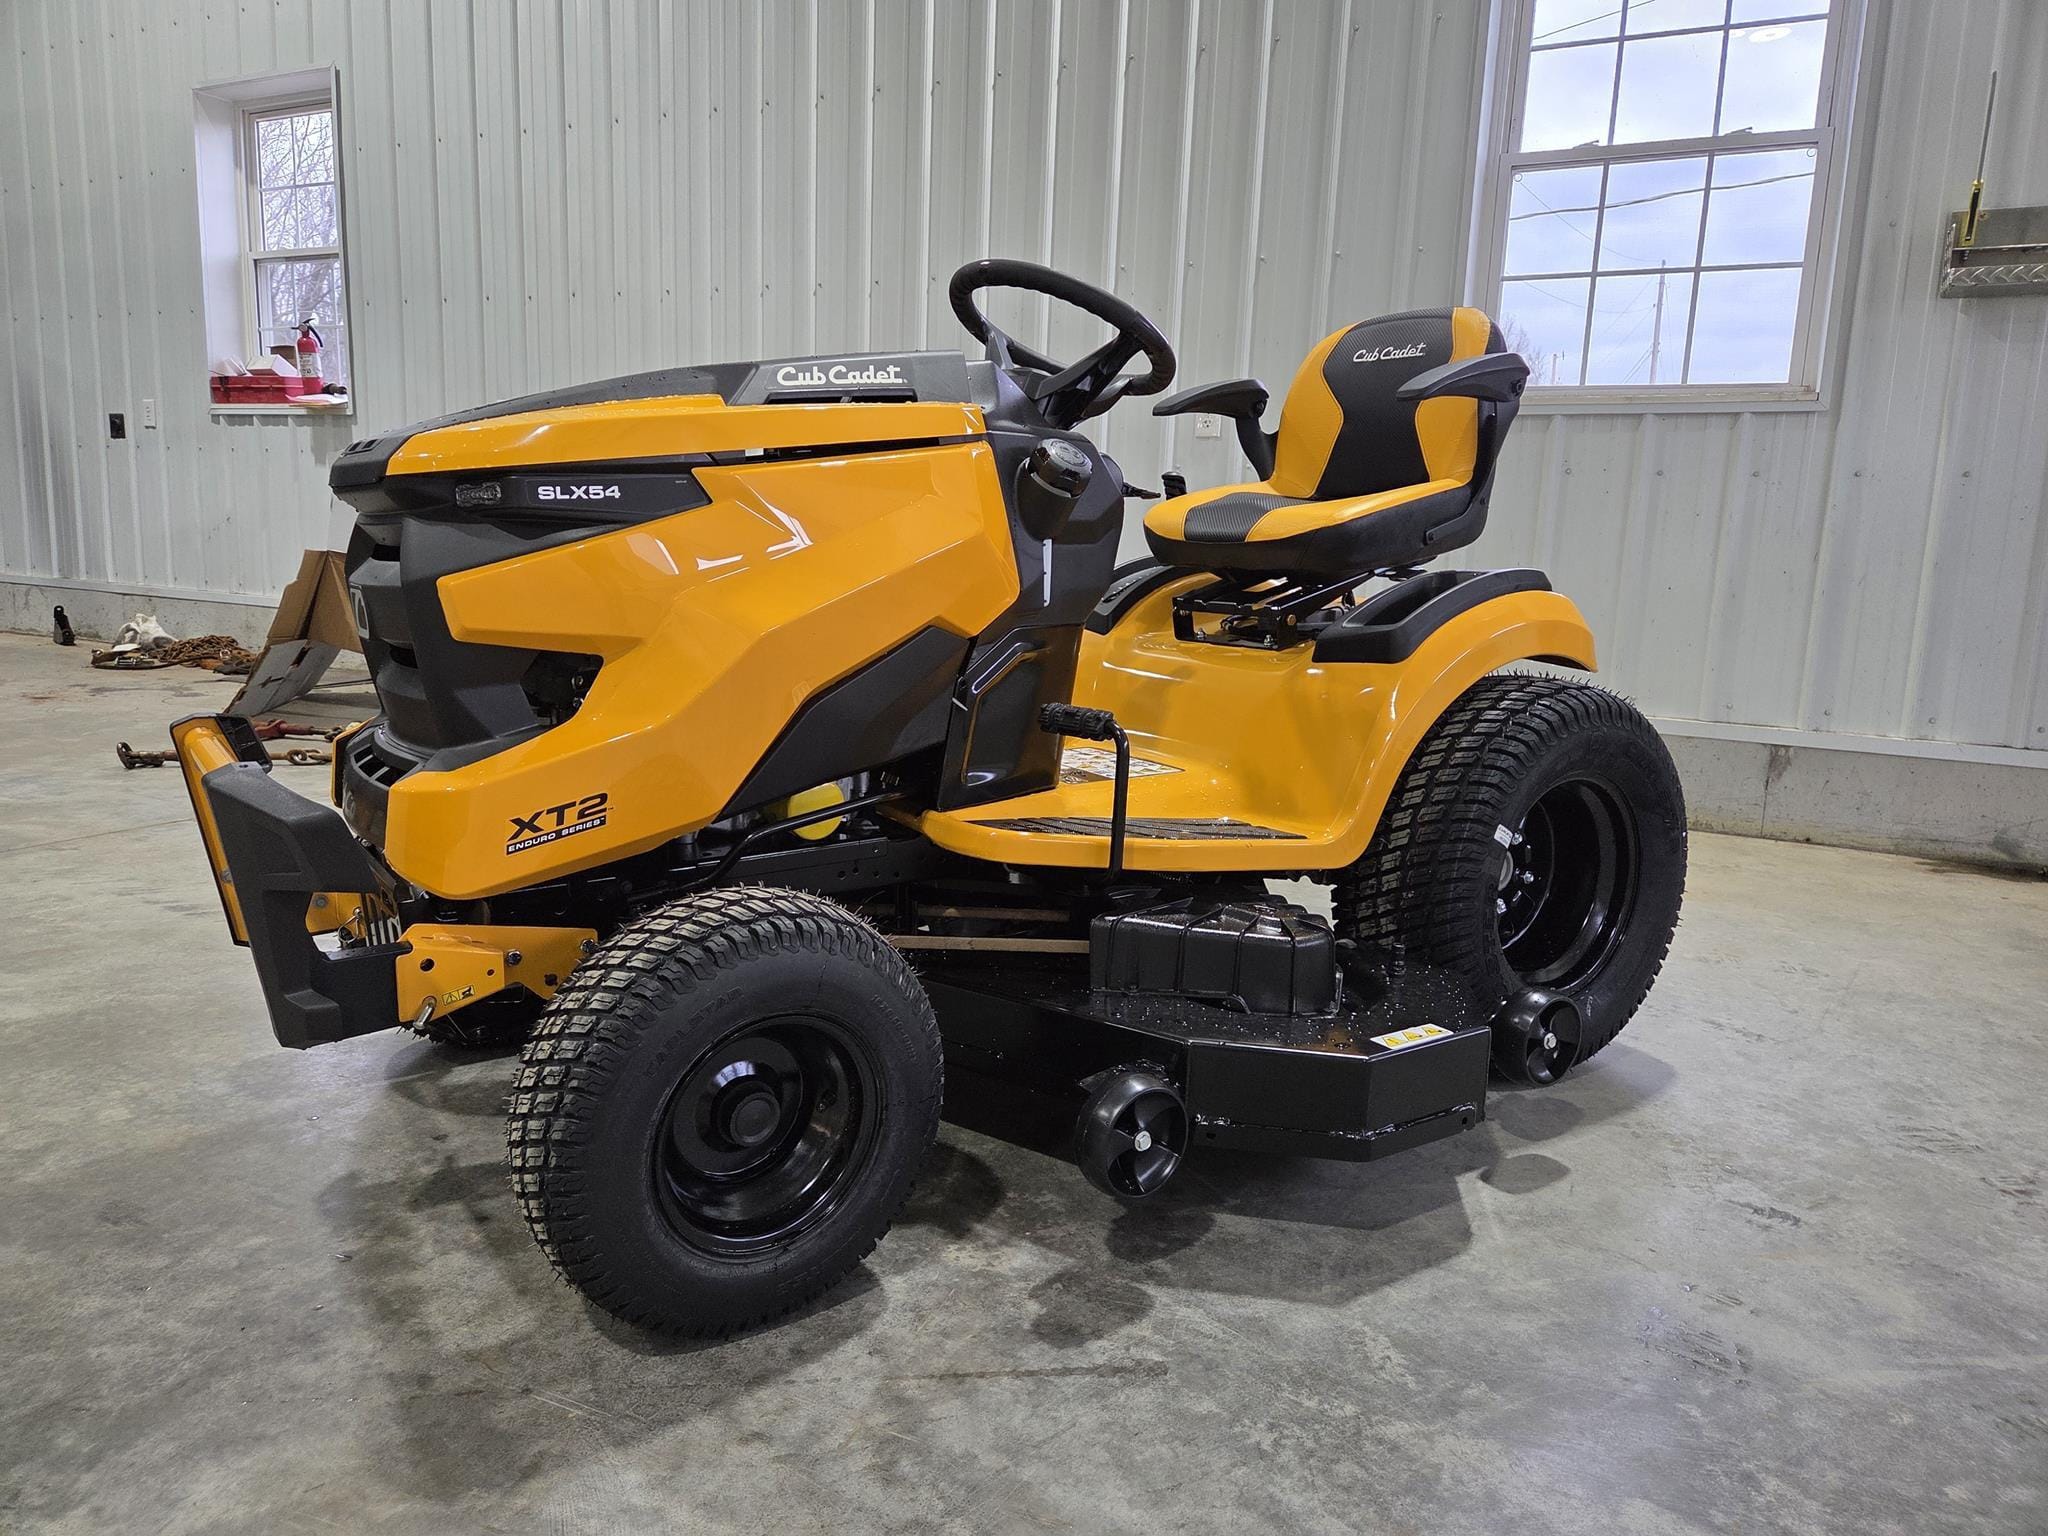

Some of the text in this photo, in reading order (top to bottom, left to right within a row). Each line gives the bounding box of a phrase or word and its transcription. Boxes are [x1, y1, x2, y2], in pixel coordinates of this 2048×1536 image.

[1353, 342, 1426, 362] Cub Cadet
[777, 365, 903, 385] Cub Cadet
[537, 485, 621, 500] SLX54
[507, 792, 608, 841] XT2
[508, 817, 602, 852] ENDURO SERIES
